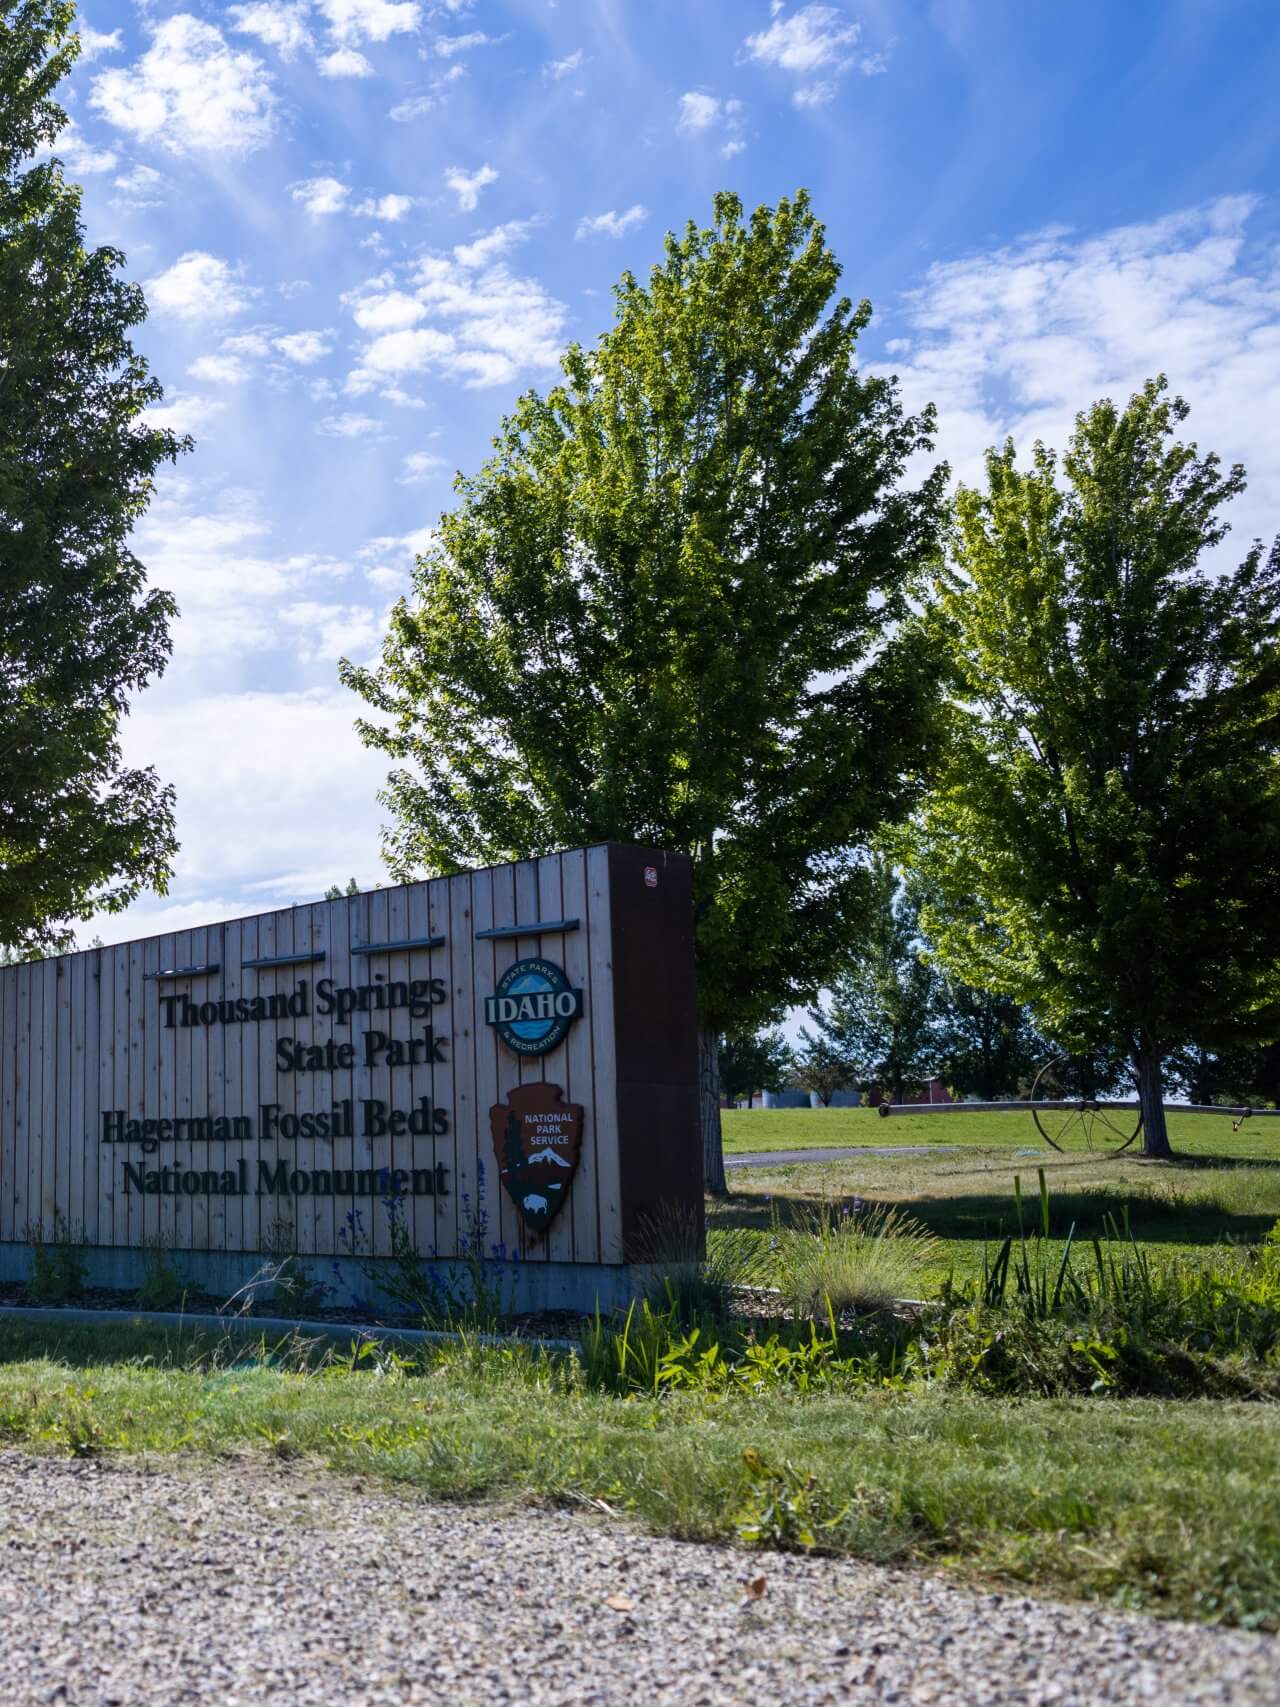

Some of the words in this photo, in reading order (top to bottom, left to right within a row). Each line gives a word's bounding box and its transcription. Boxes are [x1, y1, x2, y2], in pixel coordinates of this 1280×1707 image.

[502, 964, 527, 989] STATE
[530, 963, 558, 984] PARKS
[159, 979, 310, 1028] Thousand
[316, 976, 447, 1025] Springs
[488, 991, 577, 1023] IDAHO
[275, 1037, 355, 1073] State
[362, 1025, 449, 1067] Park
[511, 1025, 561, 1051] RECREATION
[101, 1109, 252, 1153] Hagerman
[260, 1099, 354, 1140] Fossil
[361, 1096, 450, 1137] Beds
[524, 1113, 573, 1124] NATIONAL
[536, 1125, 561, 1134] PARK
[530, 1135, 569, 1145] SERVICE
[121, 1158, 249, 1196] National
[257, 1159, 451, 1197] Monument
